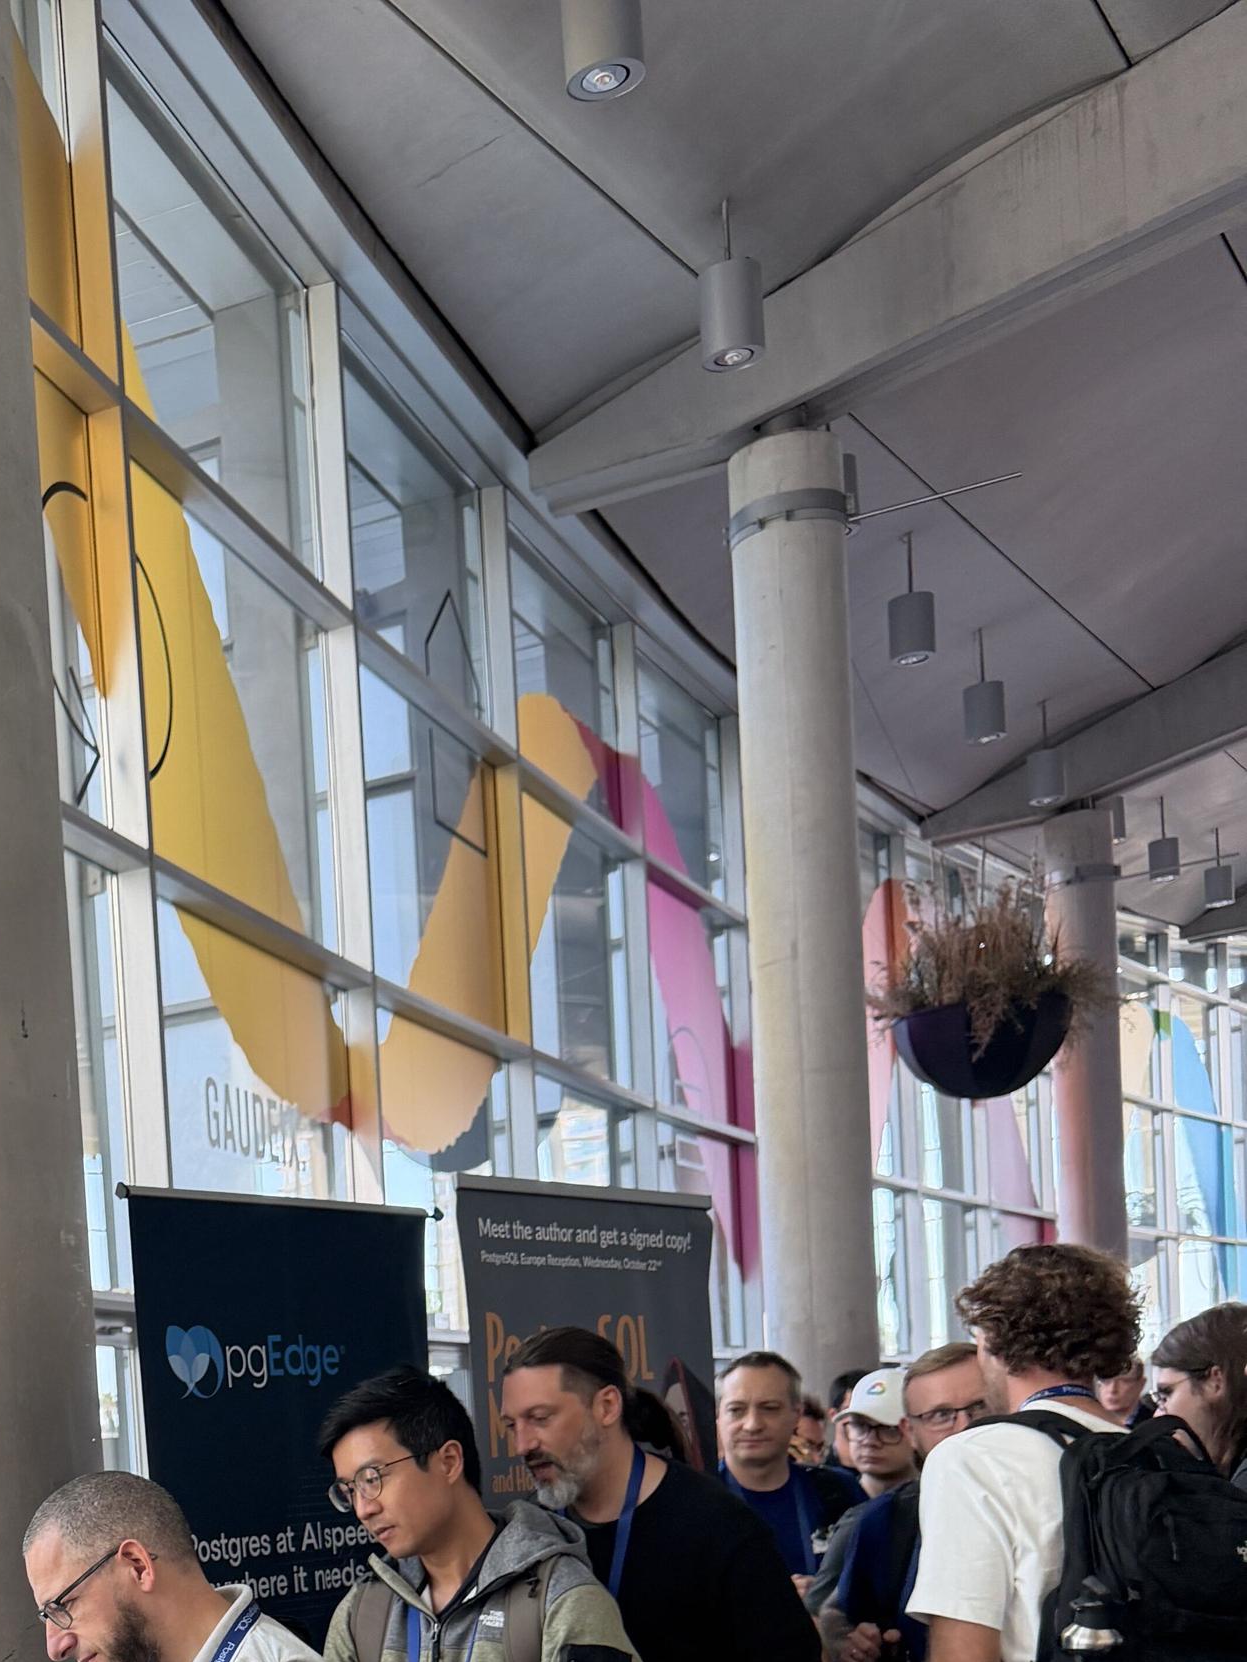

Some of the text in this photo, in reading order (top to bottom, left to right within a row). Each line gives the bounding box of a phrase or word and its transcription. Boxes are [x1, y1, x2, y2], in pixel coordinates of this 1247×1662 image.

[478, 1217, 692, 1254] Meet the author and get a signed copy!
[480, 1250, 520, 1266] PostgreSQL
[520, 1252, 547, 1267] Europe
[547, 1254, 582, 1269] Reception,
[582, 1256, 622, 1270] Wednesday,
[623, 1258, 647, 1270] October
[492, 1465, 537, 1493] and Ho
[276, 1526, 296, 1554] at
[293, 1565, 309, 1594] it
